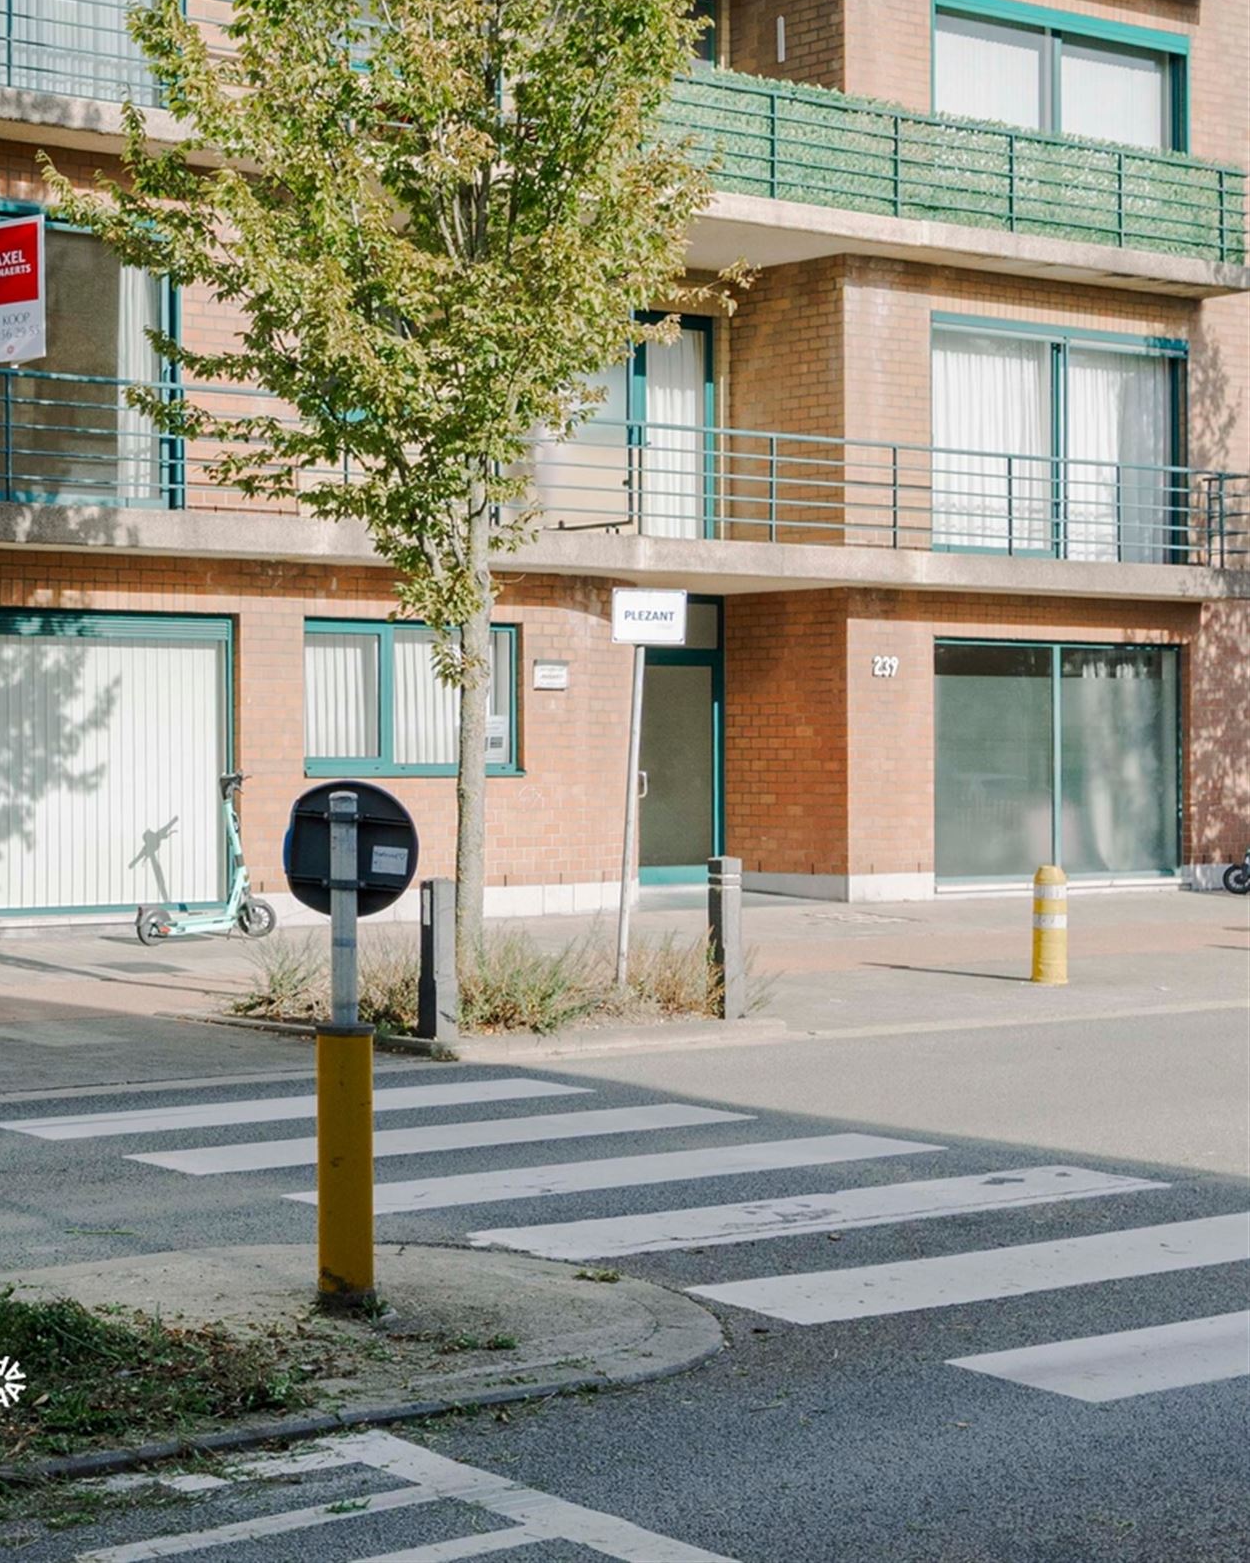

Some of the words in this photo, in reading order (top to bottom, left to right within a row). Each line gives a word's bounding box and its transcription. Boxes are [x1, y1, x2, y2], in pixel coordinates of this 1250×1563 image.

[2, 312, 30, 326] KOOP
[624, 610, 675, 622] PLEZANT
[874, 655, 899, 677] 239
